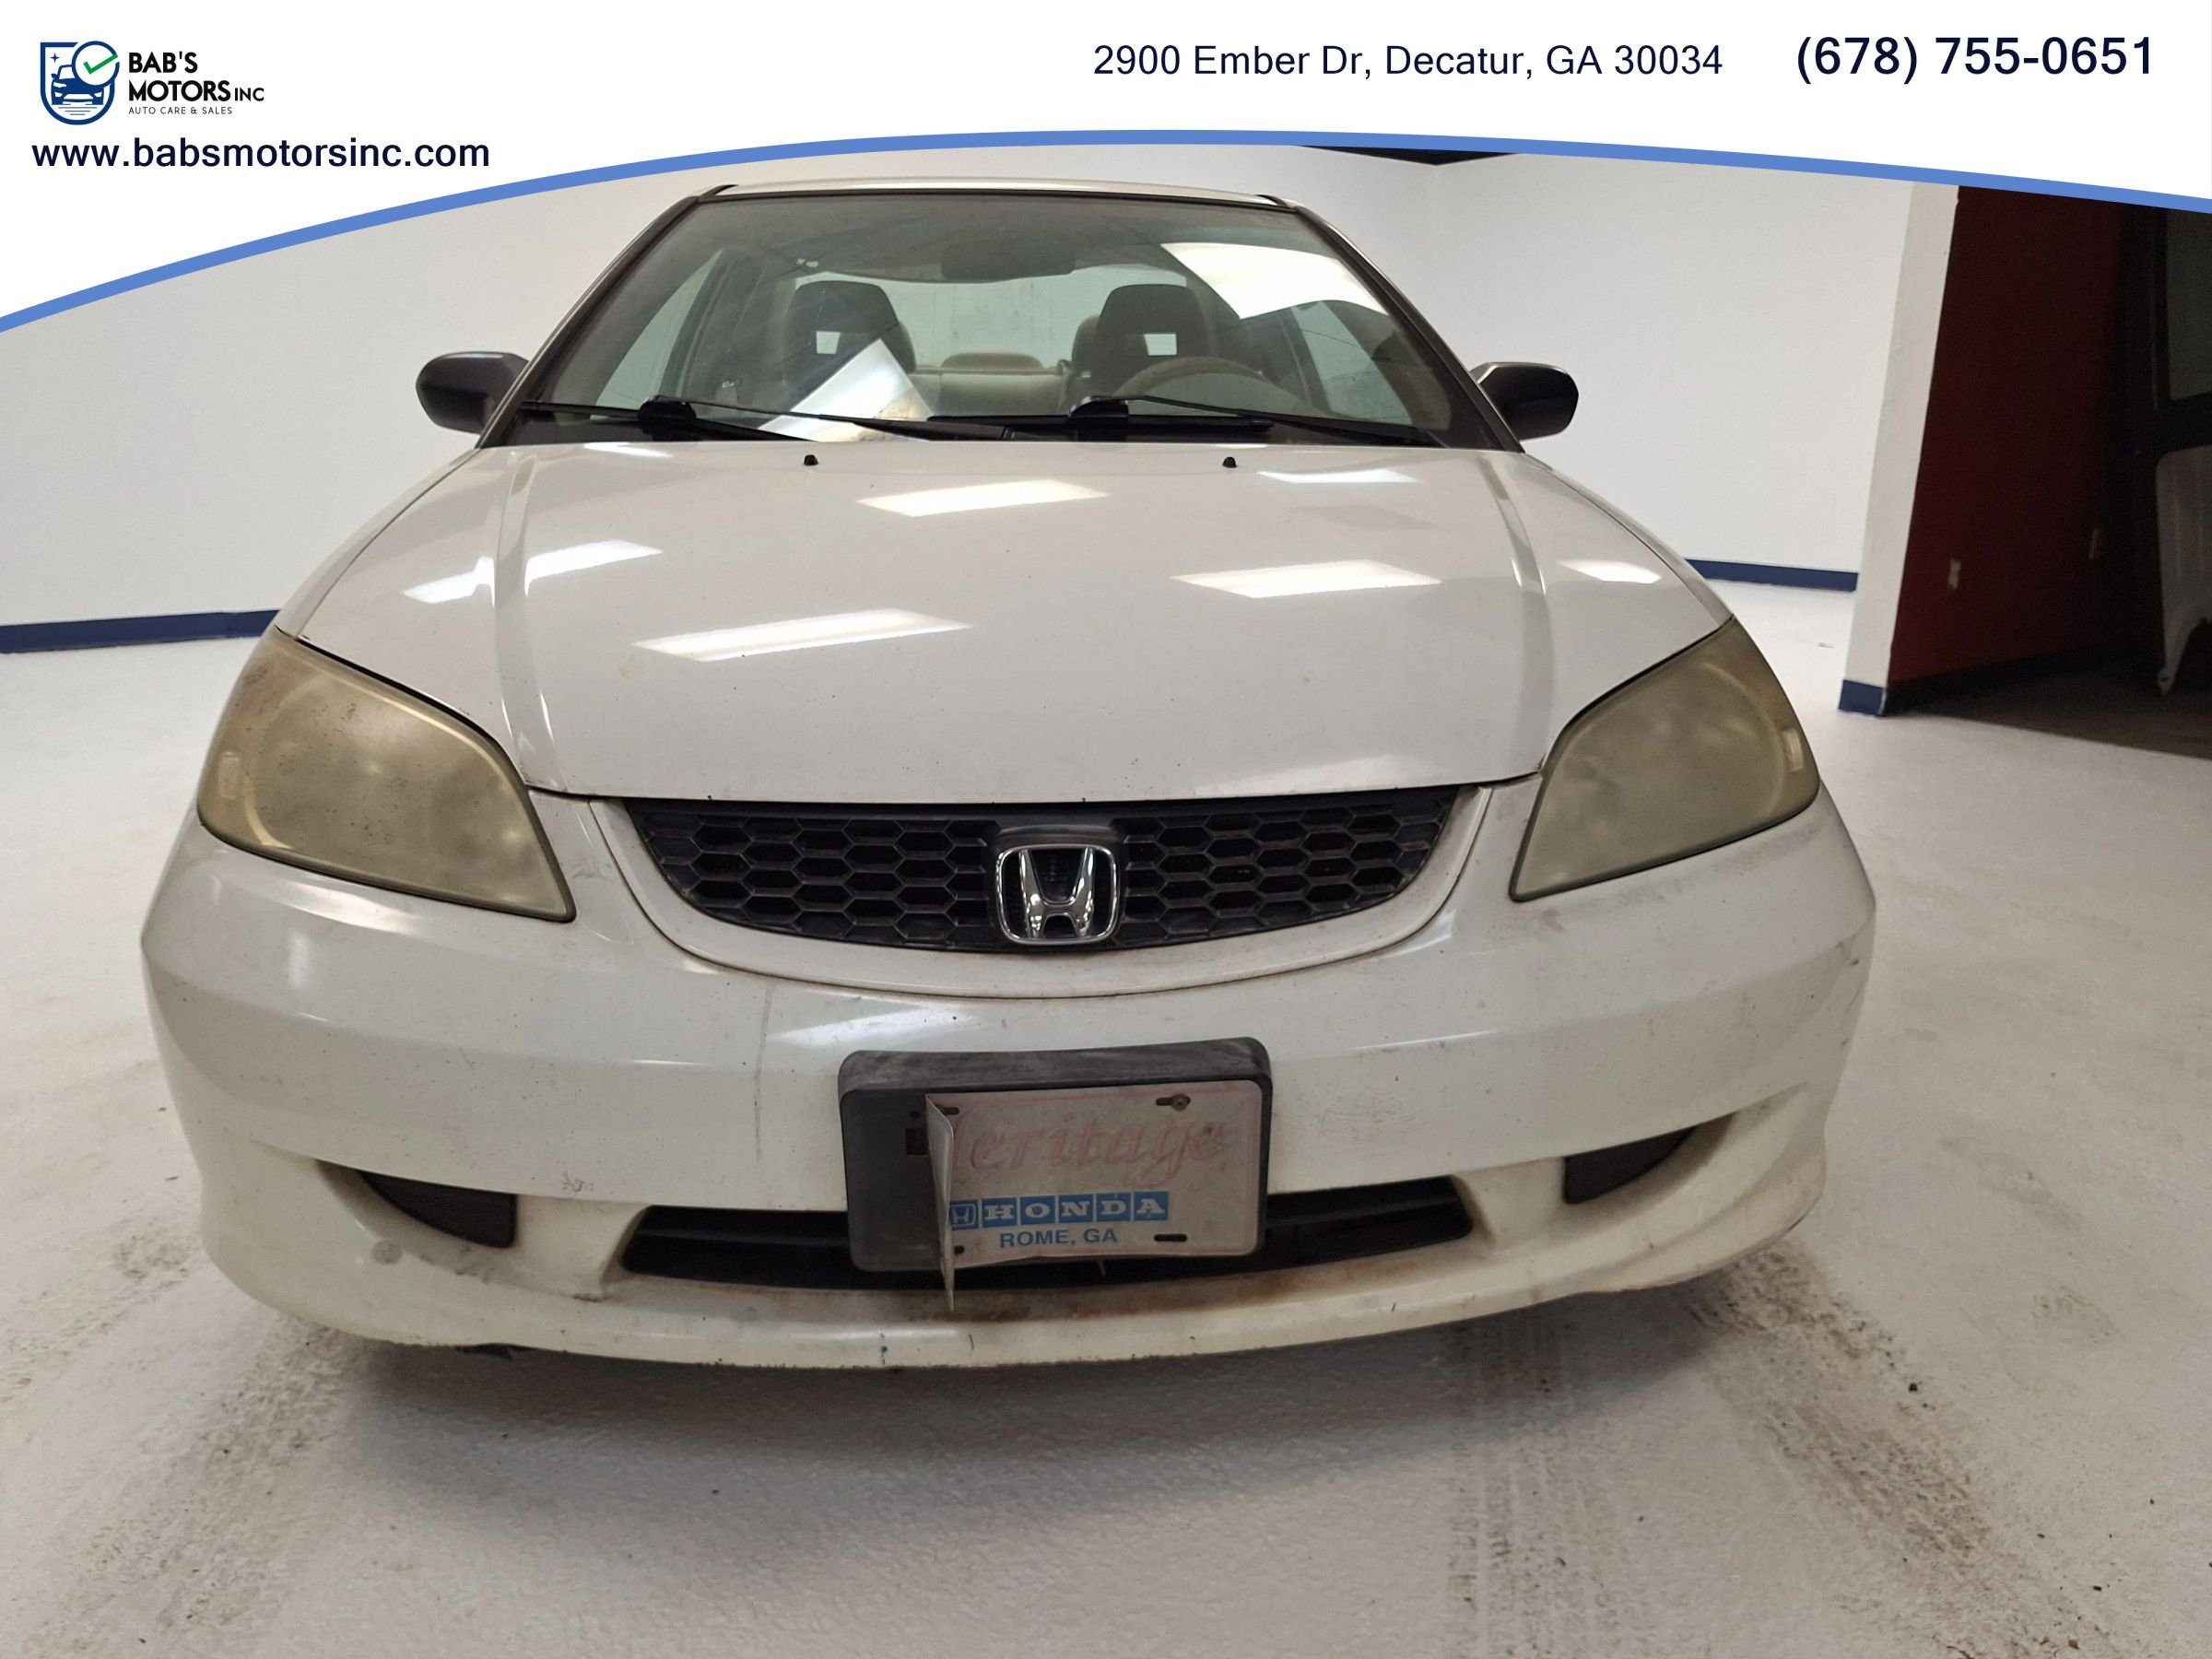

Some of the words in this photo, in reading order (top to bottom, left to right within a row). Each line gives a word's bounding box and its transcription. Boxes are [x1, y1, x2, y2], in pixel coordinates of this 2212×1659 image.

[983, 1196, 1167, 1221] HONDA
[999, 1229, 1077, 1249] ROME,
[1083, 1228, 1118, 1244] GA
